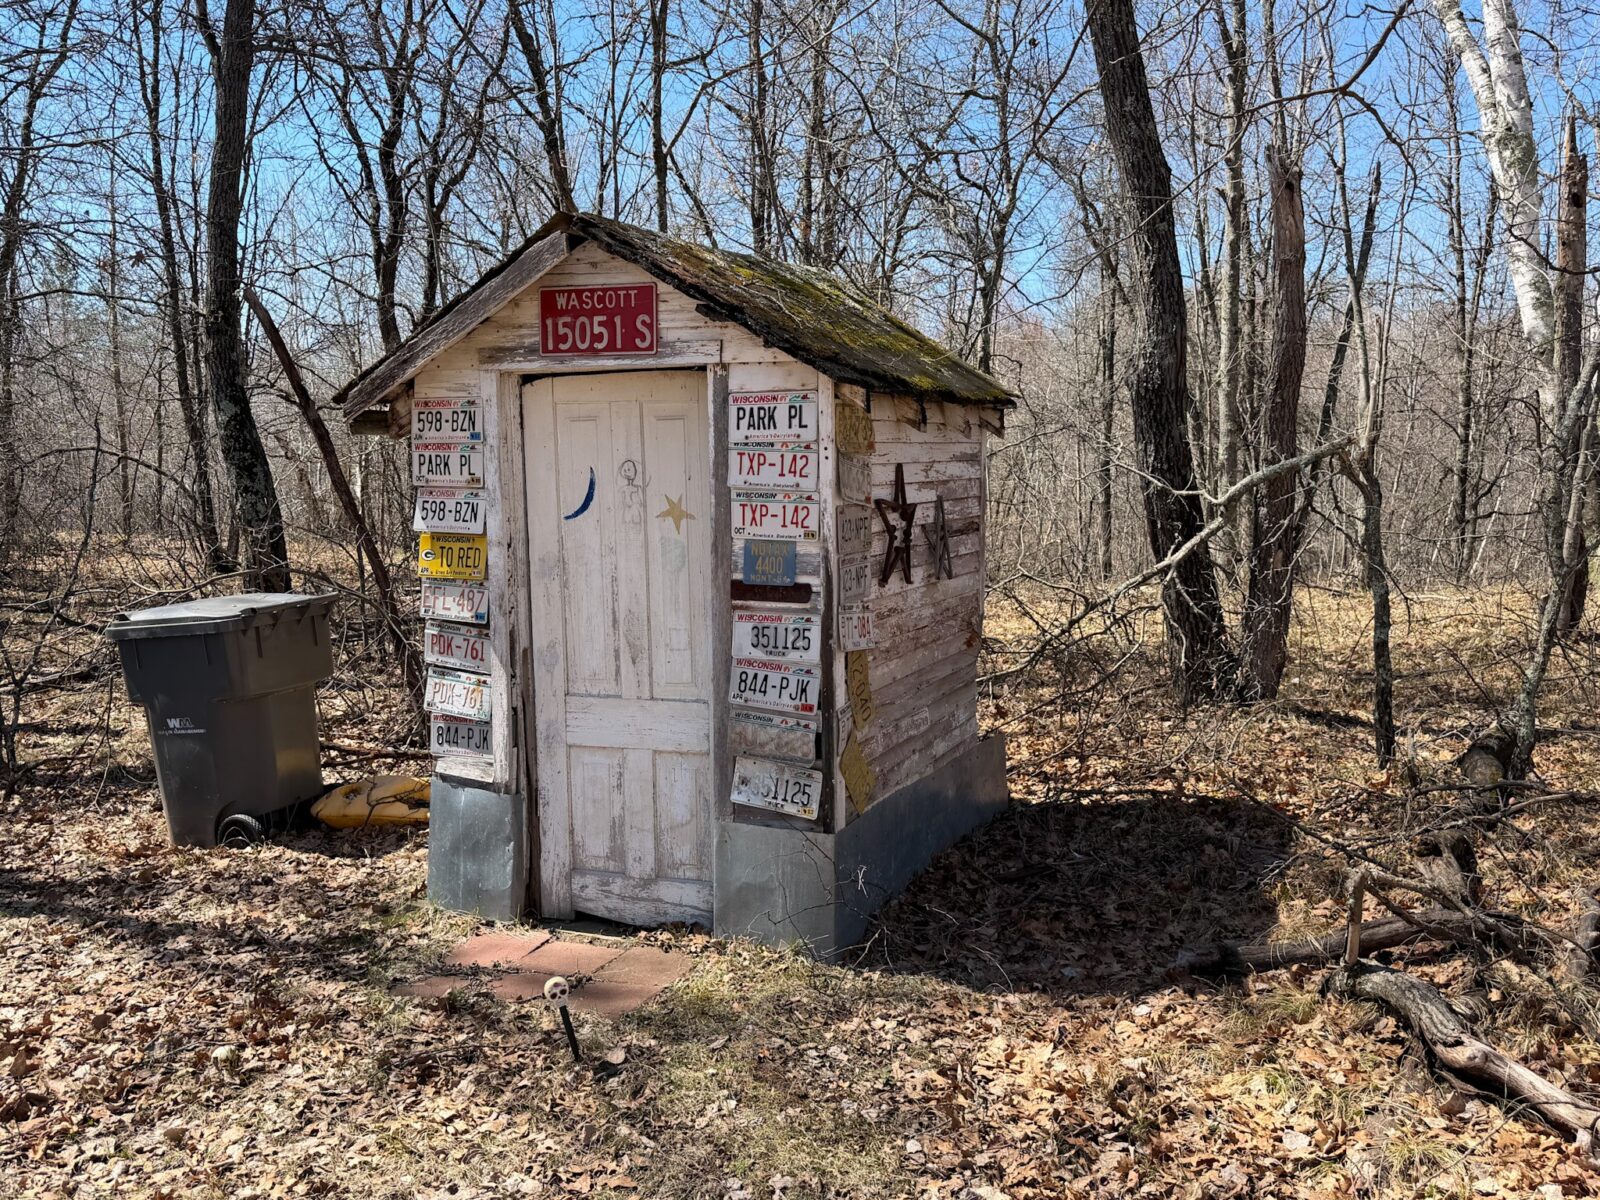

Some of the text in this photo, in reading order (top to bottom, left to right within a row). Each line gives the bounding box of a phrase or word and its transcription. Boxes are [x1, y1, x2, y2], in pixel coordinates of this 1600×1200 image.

[555, 290, 638, 310] WASCOTT
[545, 313, 652, 351] 15051 S
[414, 400, 452, 408] WISCONSIN
[732, 395, 779, 403] WISCONSIN
[418, 410, 476, 432] 598-BZN
[736, 405, 808, 430] PARK PL
[415, 443, 452, 451] WISCONSIN
[418, 454, 475, 476] PARK PL
[737, 452, 808, 478] TXP-142
[420, 489, 456, 497] WISCONSIN
[421, 500, 479, 523] 598-BZN
[739, 503, 810, 528] TXP-142
[436, 536, 471, 544] WISCONSIN
[734, 527, 745, 535] OCT
[439, 546, 481, 568] TO RED
[756, 557, 783, 574] 4400
[422, 586, 485, 613] EFL-487
[430, 622, 461, 632] WISCONSIN
[737, 613, 783, 622] WISCONSIN
[431, 634, 485, 662] PDK-761
[751, 626, 812, 650] 351125
[432, 670, 461, 679] WISCONSIN
[736, 658, 783, 671] WISCONSIN
[432, 681, 484, 711] PDK-761
[738, 671, 811, 703] 844-PJK
[433, 714, 467, 723] WISCONSIN
[735, 712, 773, 723] WISCONSIN
[437, 726, 489, 750] 844-PJK
